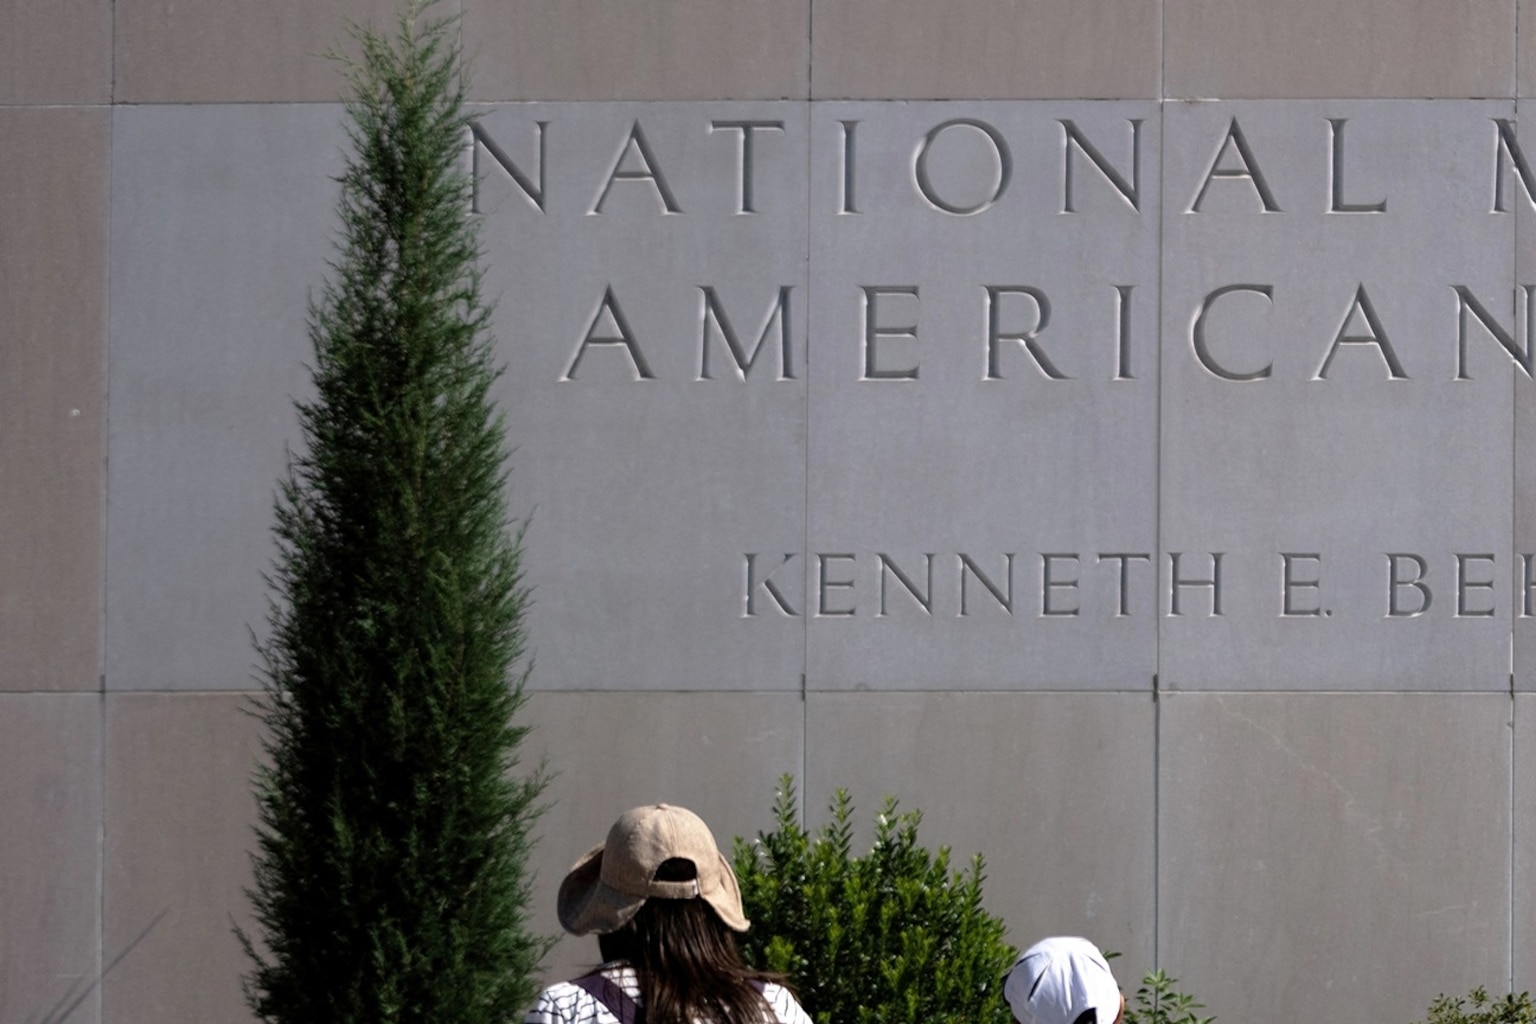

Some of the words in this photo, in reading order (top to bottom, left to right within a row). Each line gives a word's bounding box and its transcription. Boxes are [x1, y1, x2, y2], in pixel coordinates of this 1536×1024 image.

[468, 118, 1388, 216] NATIONAL
[741, 552, 1225, 620] KENNETH
[1277, 552, 1334, 620] E.
